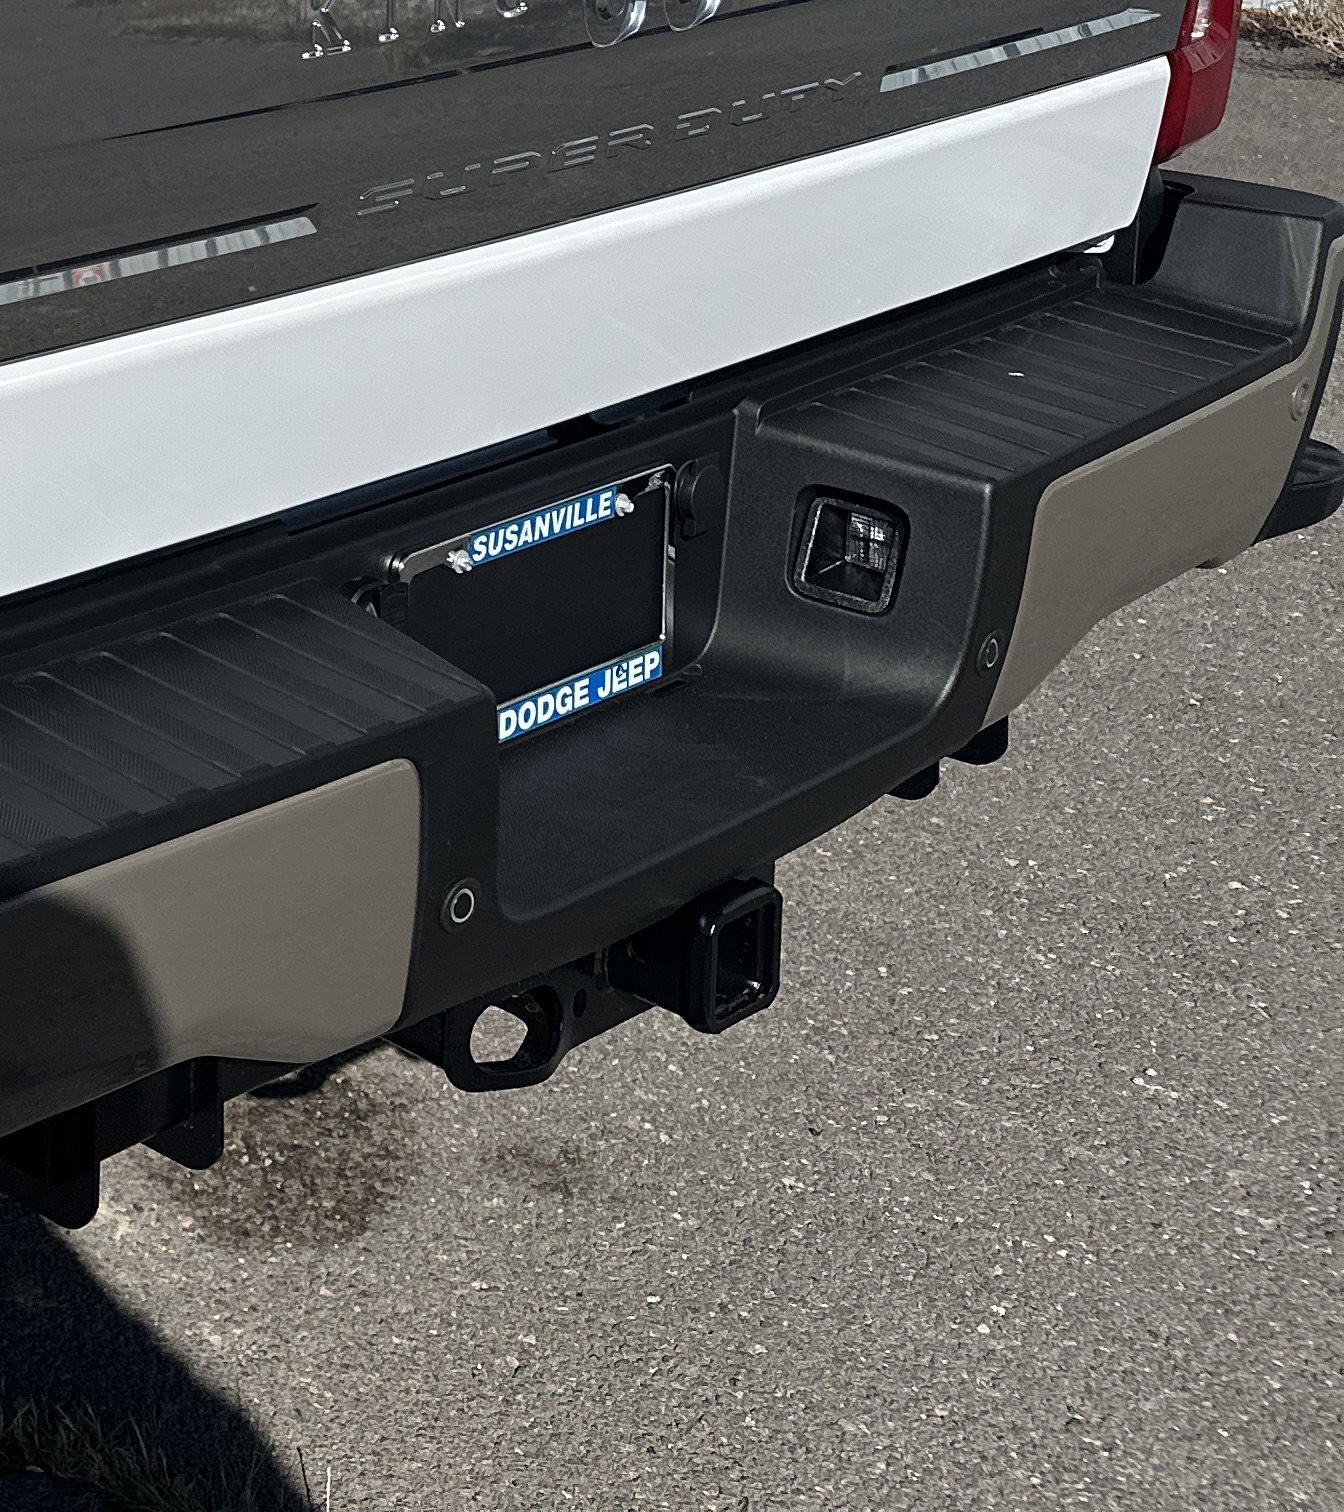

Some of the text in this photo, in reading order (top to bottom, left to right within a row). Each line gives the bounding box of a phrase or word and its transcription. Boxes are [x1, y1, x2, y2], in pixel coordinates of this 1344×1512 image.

[356, 70, 863, 217] SUPER DUTY
[472, 491, 613, 563] SUSANVILLE
[498, 650, 661, 741] DODGE JEEP
